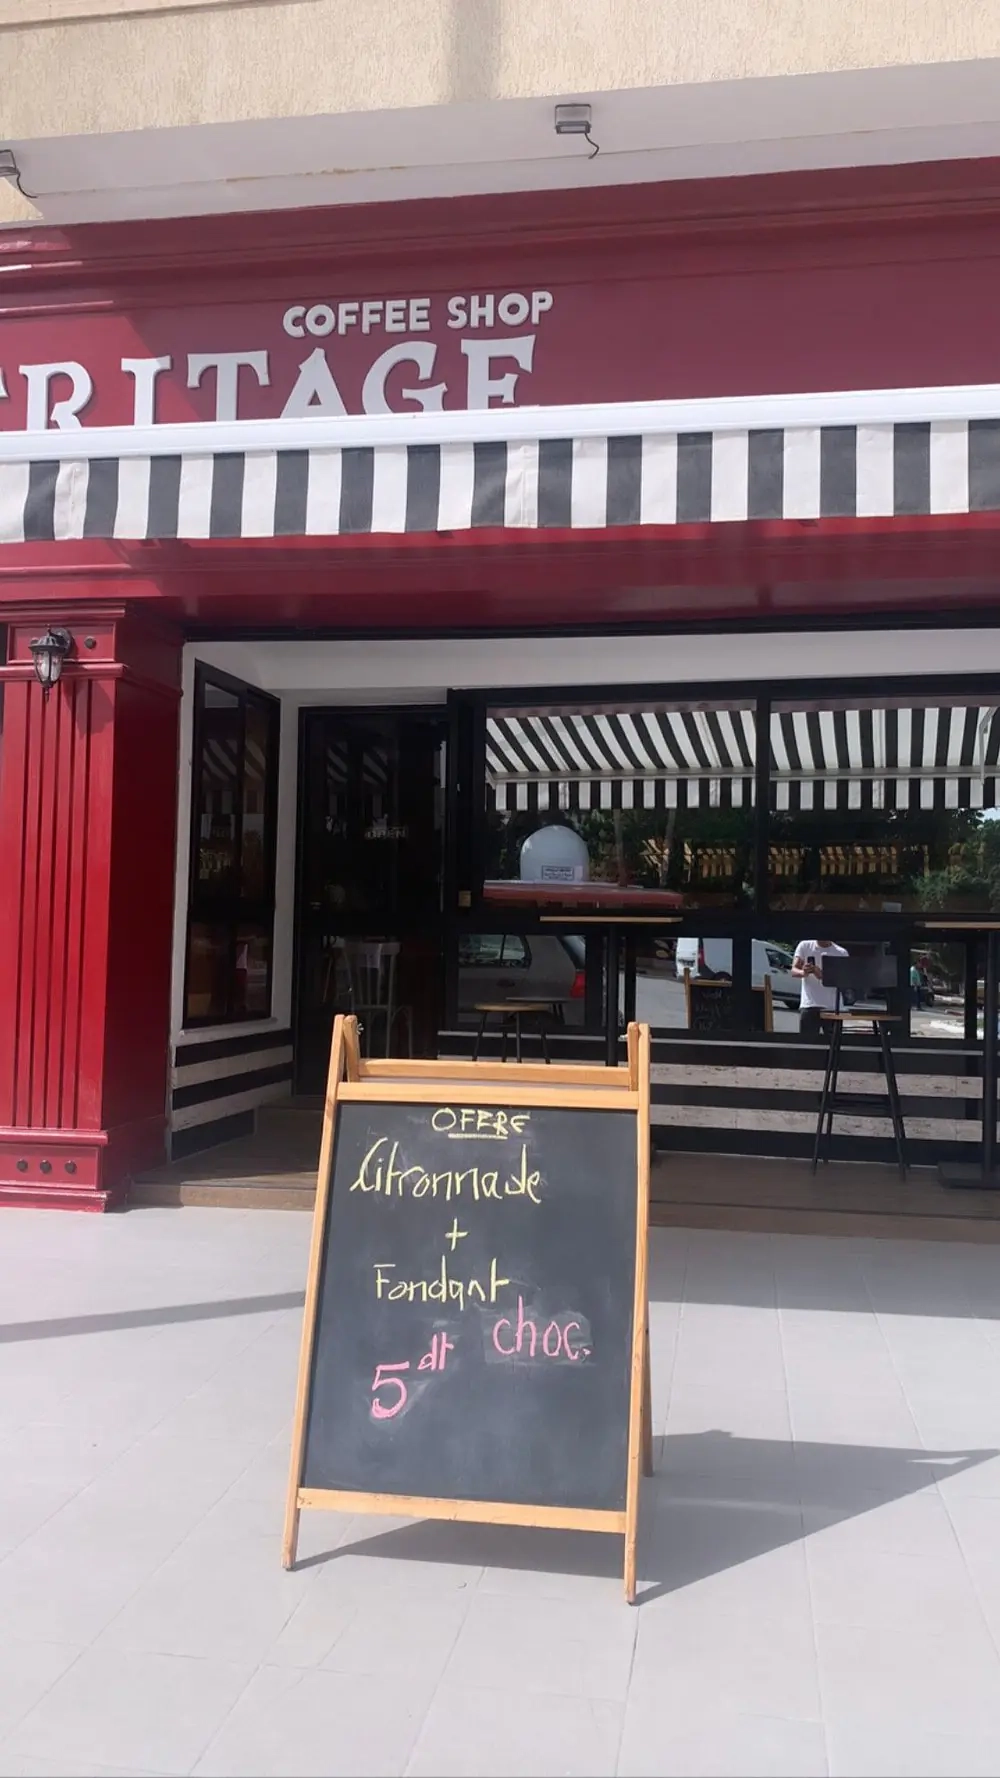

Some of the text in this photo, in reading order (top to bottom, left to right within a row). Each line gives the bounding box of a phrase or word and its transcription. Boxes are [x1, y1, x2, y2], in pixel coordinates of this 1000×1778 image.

[283, 291, 553, 338] COFFEE SHOP
[0, 335, 535, 431] RITAGE
[432, 1107, 530, 1136] OFFRE
[349, 1137, 541, 1204] Citronnade
[445, 1218, 468, 1250] +
[373, 1255, 509, 1310] Fondant
[371, 1361, 409, 1419] 5
